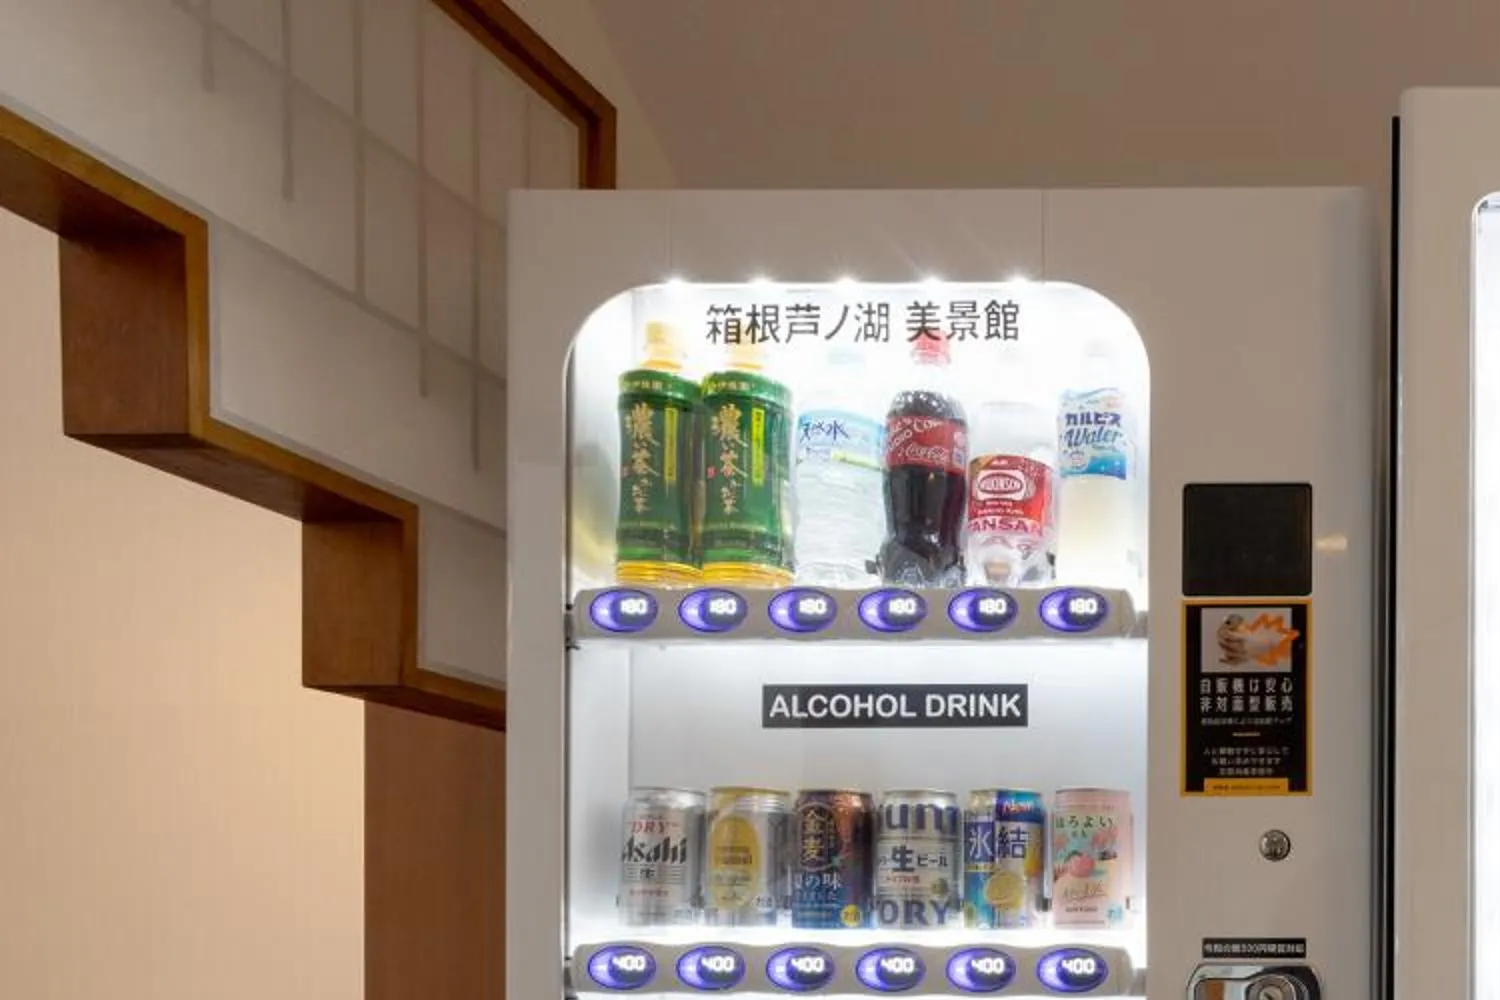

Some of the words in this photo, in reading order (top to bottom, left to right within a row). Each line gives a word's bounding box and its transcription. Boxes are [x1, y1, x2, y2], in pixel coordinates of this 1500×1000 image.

[706, 303, 889, 343] 箱根芦ノ湖
[906, 300, 1020, 341] 美景館
[1065, 411, 1121, 427] カルピス
[769, 694, 917, 718] ALCOHOL
[925, 693, 1021, 718] DRINK
[621, 836, 688, 864] Asahi
[969, 825, 1029, 863] 氷結
[612, 956, 646, 972] 400
[702, 956, 735, 972] 400
[791, 956, 825, 972] 400
[881, 957, 915, 973] 400
[971, 957, 1005, 973] 400
[1062, 957, 1096, 974] 400
